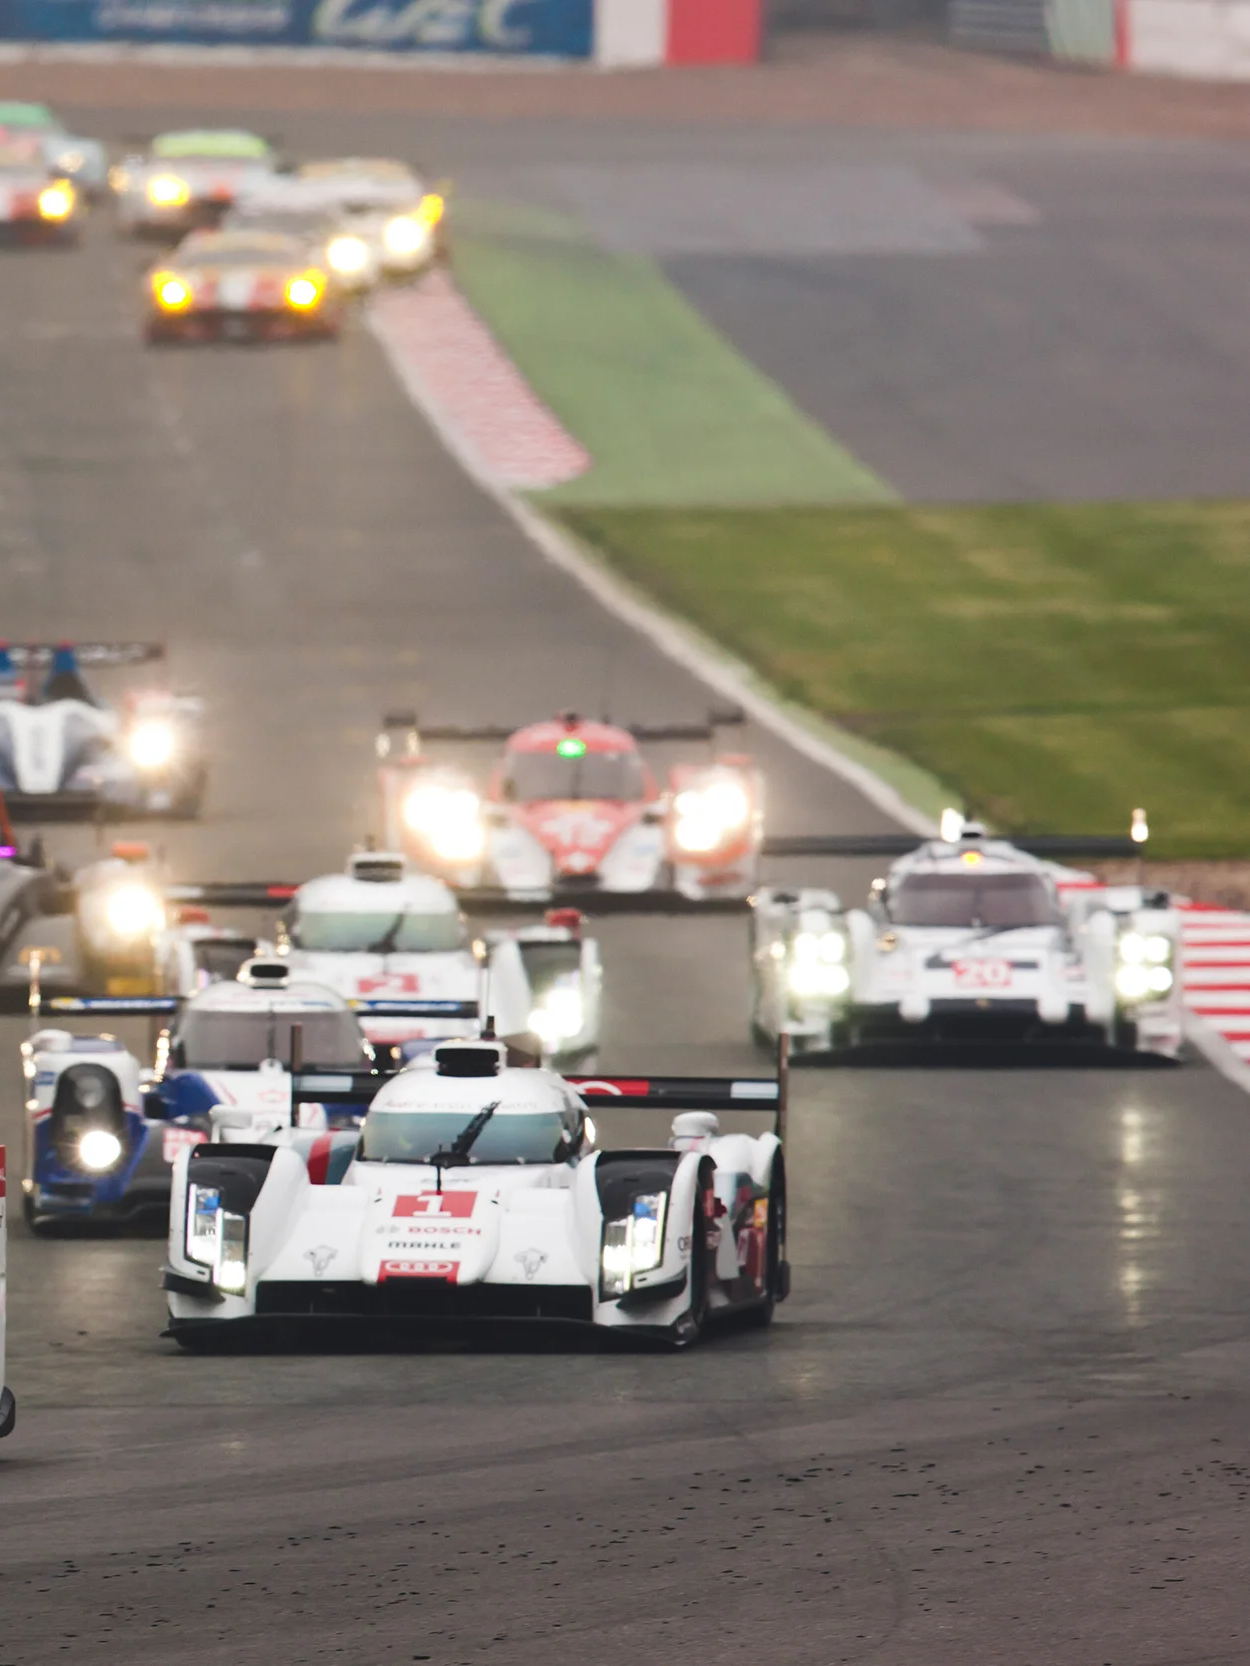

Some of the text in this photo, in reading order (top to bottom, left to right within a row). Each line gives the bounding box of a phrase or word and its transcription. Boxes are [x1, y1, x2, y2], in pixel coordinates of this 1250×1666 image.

[956, 958, 1012, 987] 20
[412, 1194, 452, 1217] 1
[407, 1226, 482, 1235] BOSCH
[388, 1241, 461, 1249] MAHLE
